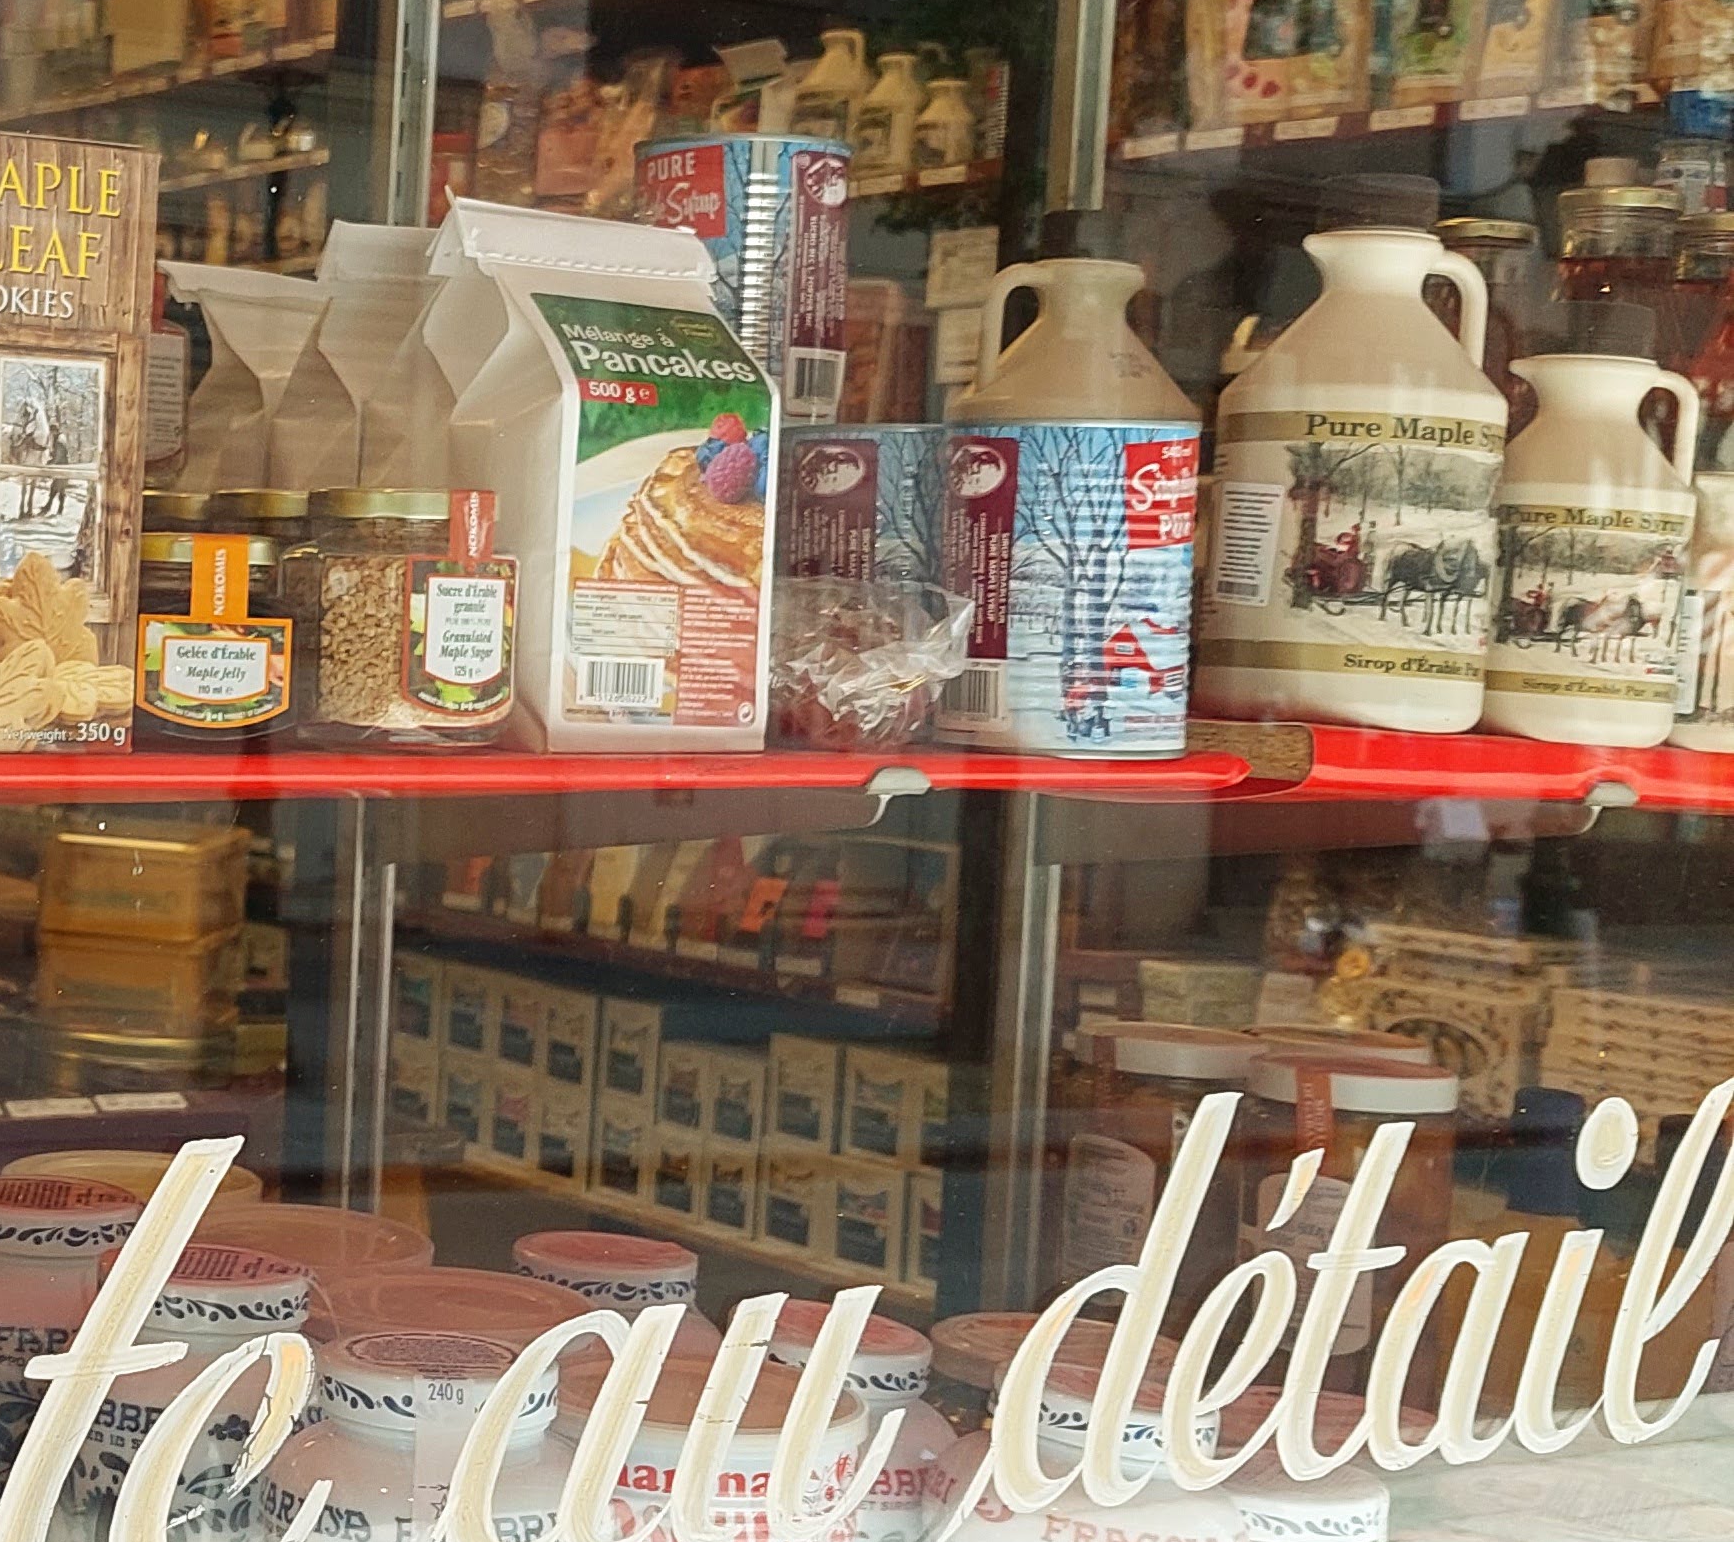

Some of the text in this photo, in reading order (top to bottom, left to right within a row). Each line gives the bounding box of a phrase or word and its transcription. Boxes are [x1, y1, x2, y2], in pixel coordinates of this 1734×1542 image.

[648, 151, 696, 185] PURE
[560, 321, 654, 350] Mélange
[573, 339, 758, 385] Pancakes
[587, 380, 636, 405] 500 g
[1305, 413, 1475, 448] Pure Maple
[466, 491, 479, 557] NOKOMIS
[1505, 507, 1634, 530] Pure Maple
[213, 548, 227, 617] NOKOMIS
[442, 629, 494, 643] Granulated
[176, 645, 257, 661] Gelée d'Érable
[439, 645, 494, 662] Maple Sugar
[1343, 653, 1396, 673] Sirop
[186, 666, 247, 681] Maple Jelly
[1522, 677, 1561, 692] Sirop
[76, 721, 126, 747] 350 g
[427, 1382, 464, 1405] 240 g
